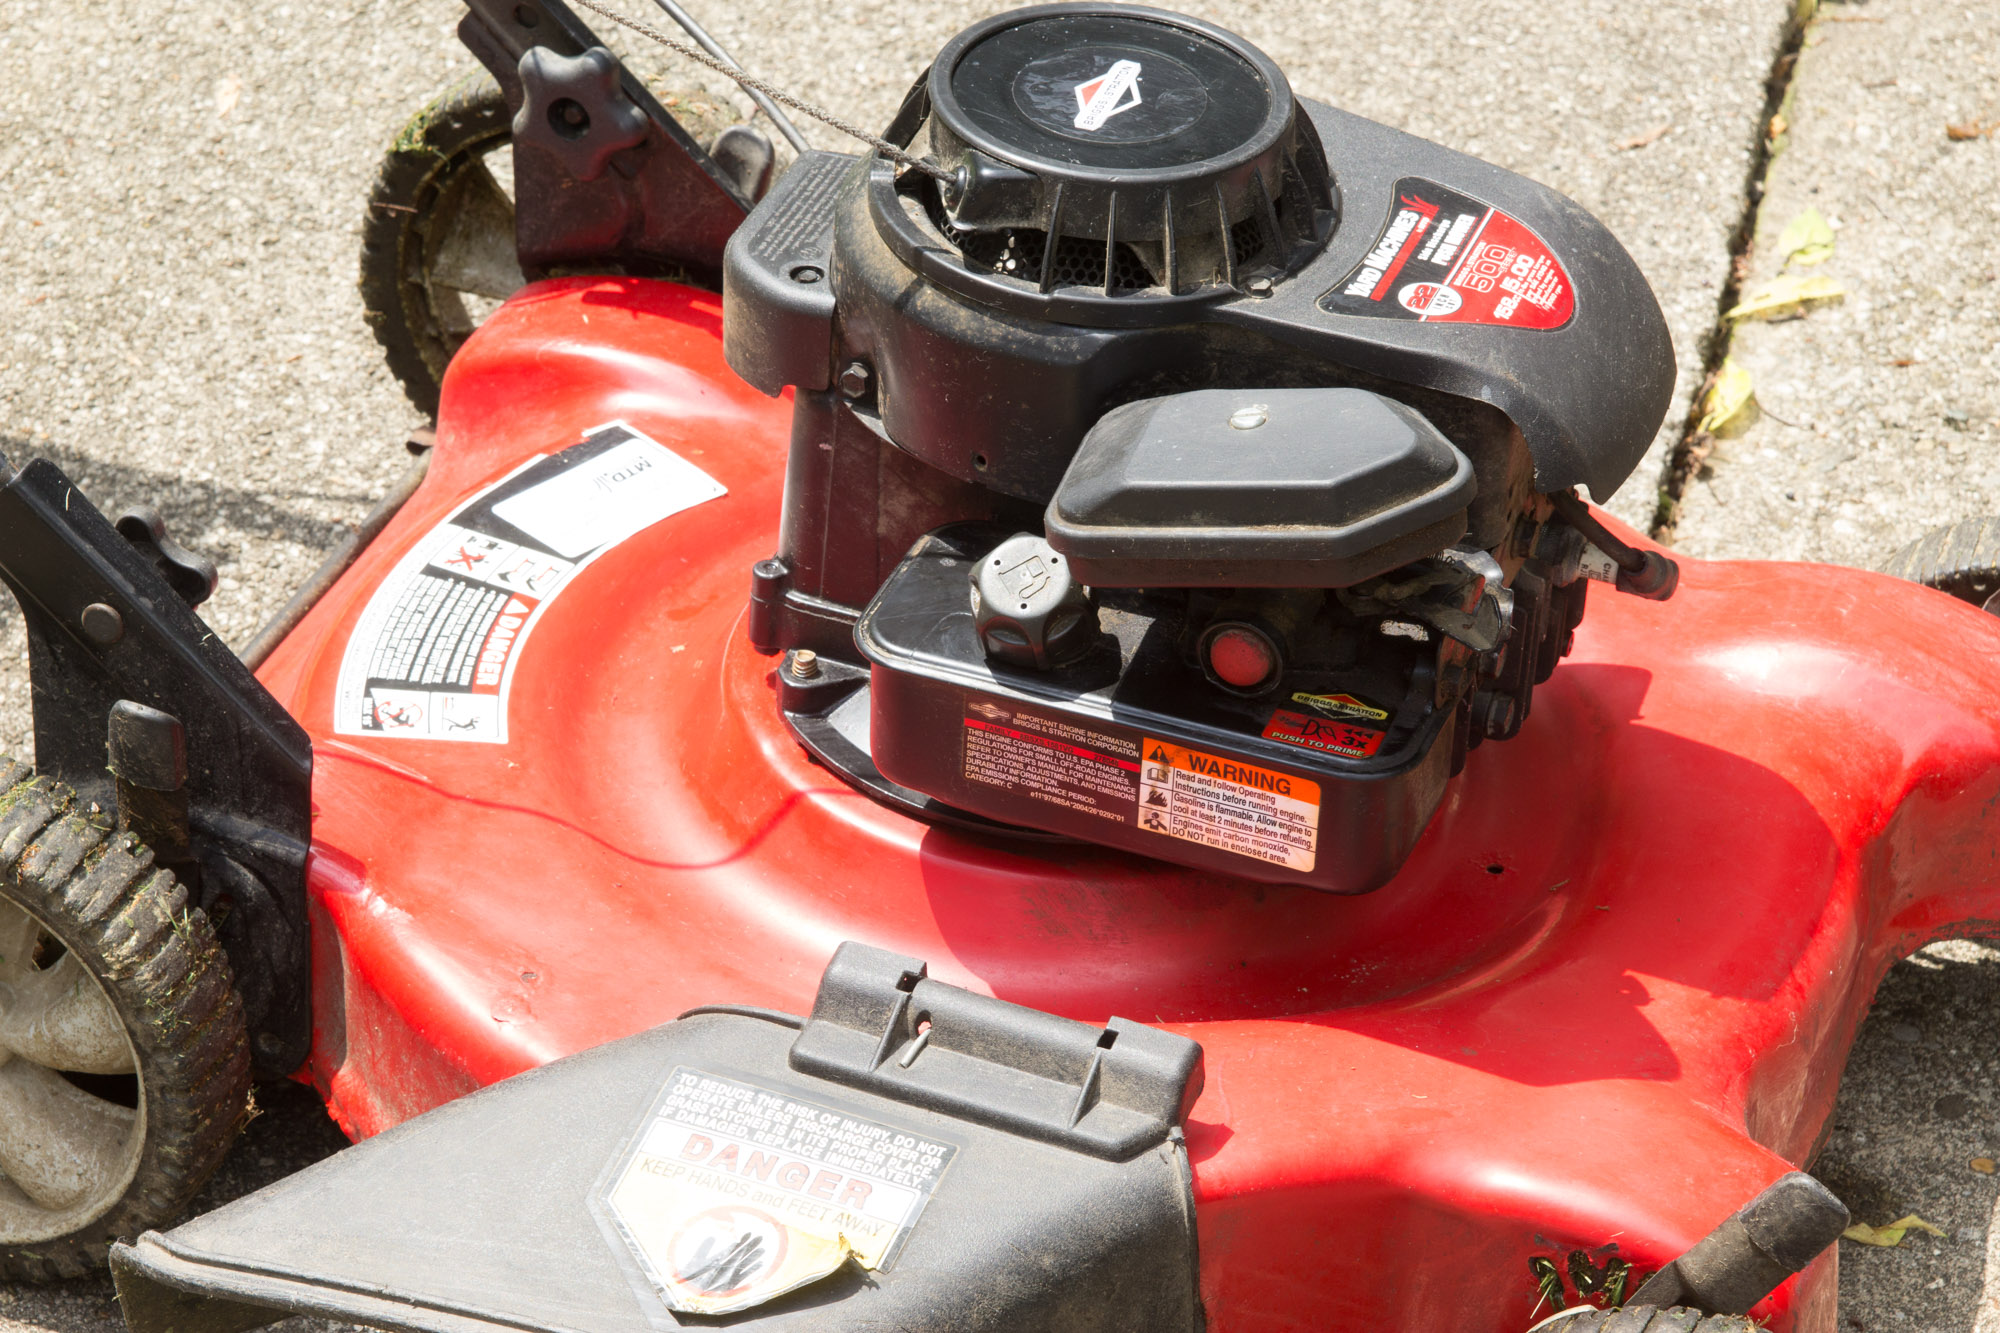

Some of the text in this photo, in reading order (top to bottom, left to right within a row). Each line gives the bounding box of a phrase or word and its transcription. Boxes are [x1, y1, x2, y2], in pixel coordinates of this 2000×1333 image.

[1104, 66, 1132, 97] STRATTON
[1344, 210, 1420, 297] YARD MACHINES
[1463, 244, 1508, 293] 500
[1504, 254, 1535, 291] 5.00
[1405, 283, 1437, 309] 22
[475, 616, 522, 686] DANGER
[1297, 694, 1331, 707] BRIGGS
[985, 723, 1011, 737] FAMILY
[1012, 717, 1040, 731] BRIGGS
[1048, 727, 1085, 743] STRATTON
[1086, 737, 1139, 757] CORPORATION
[1016, 712, 1136, 750] IMPORTANT ENGINE INFORMATION
[1271, 731, 1366, 757] PUSH TO PRIME
[965, 756, 1059, 787] DURABILITY INFORMATION.
[966, 734, 1131, 785] REGULATIONS FOR SMALL OFF-ROAD ENGINES.
[967, 727, 1125, 777] THIS ENGINE CONFORMS TO U.S. EPA PHASE 2
[967, 741, 1136, 794] REFER TO OWNER'S MANUAL FOR MAINTENANCE
[965, 770, 1012, 789] CATEGORY: C
[965, 763, 1096, 805] EPA EMISSIONS COMPLIANCE PERIOD:
[1080, 780, 1096, 790] AND
[1096, 784, 1135, 802] EMISSIONS
[1176, 769, 1275, 805] Read and follow Operating
[1188, 754, 1291, 796] WARNING
[1173, 792, 1311, 837] Gasoline is flammable. Allow engine to
[1175, 780, 1307, 824] Instructions before running engine.
[1172, 816, 1290, 856] Engines emit carbon monoxide,
[1172, 826, 1287, 864] DO NOT run in enclosed area.
[1173, 803, 1313, 849] cool at least 2 minutes before refueling.
[664, 1093, 710, 1115] GRASS
[707, 1106, 771, 1132] CATCHER
[773, 1124, 788, 1136] IS
[788, 1128, 805, 1141] IN
[804, 1133, 829, 1148] ITS
[829, 1140, 886, 1164] PROPER
[671, 1083, 942, 1169] OPERATE UNLESS DISCHARGE COVER OR
[677, 1072, 947, 1158] TO REDUCE THE RISK OF INJURY, DO NOT
[657, 1104, 926, 1189] IF DAMAGED, REPLACE IMMEDIATELY.
[677, 1132, 876, 1210] DANGER
[639, 1156, 886, 1238] KEEP HANDS and FEET AWAY
